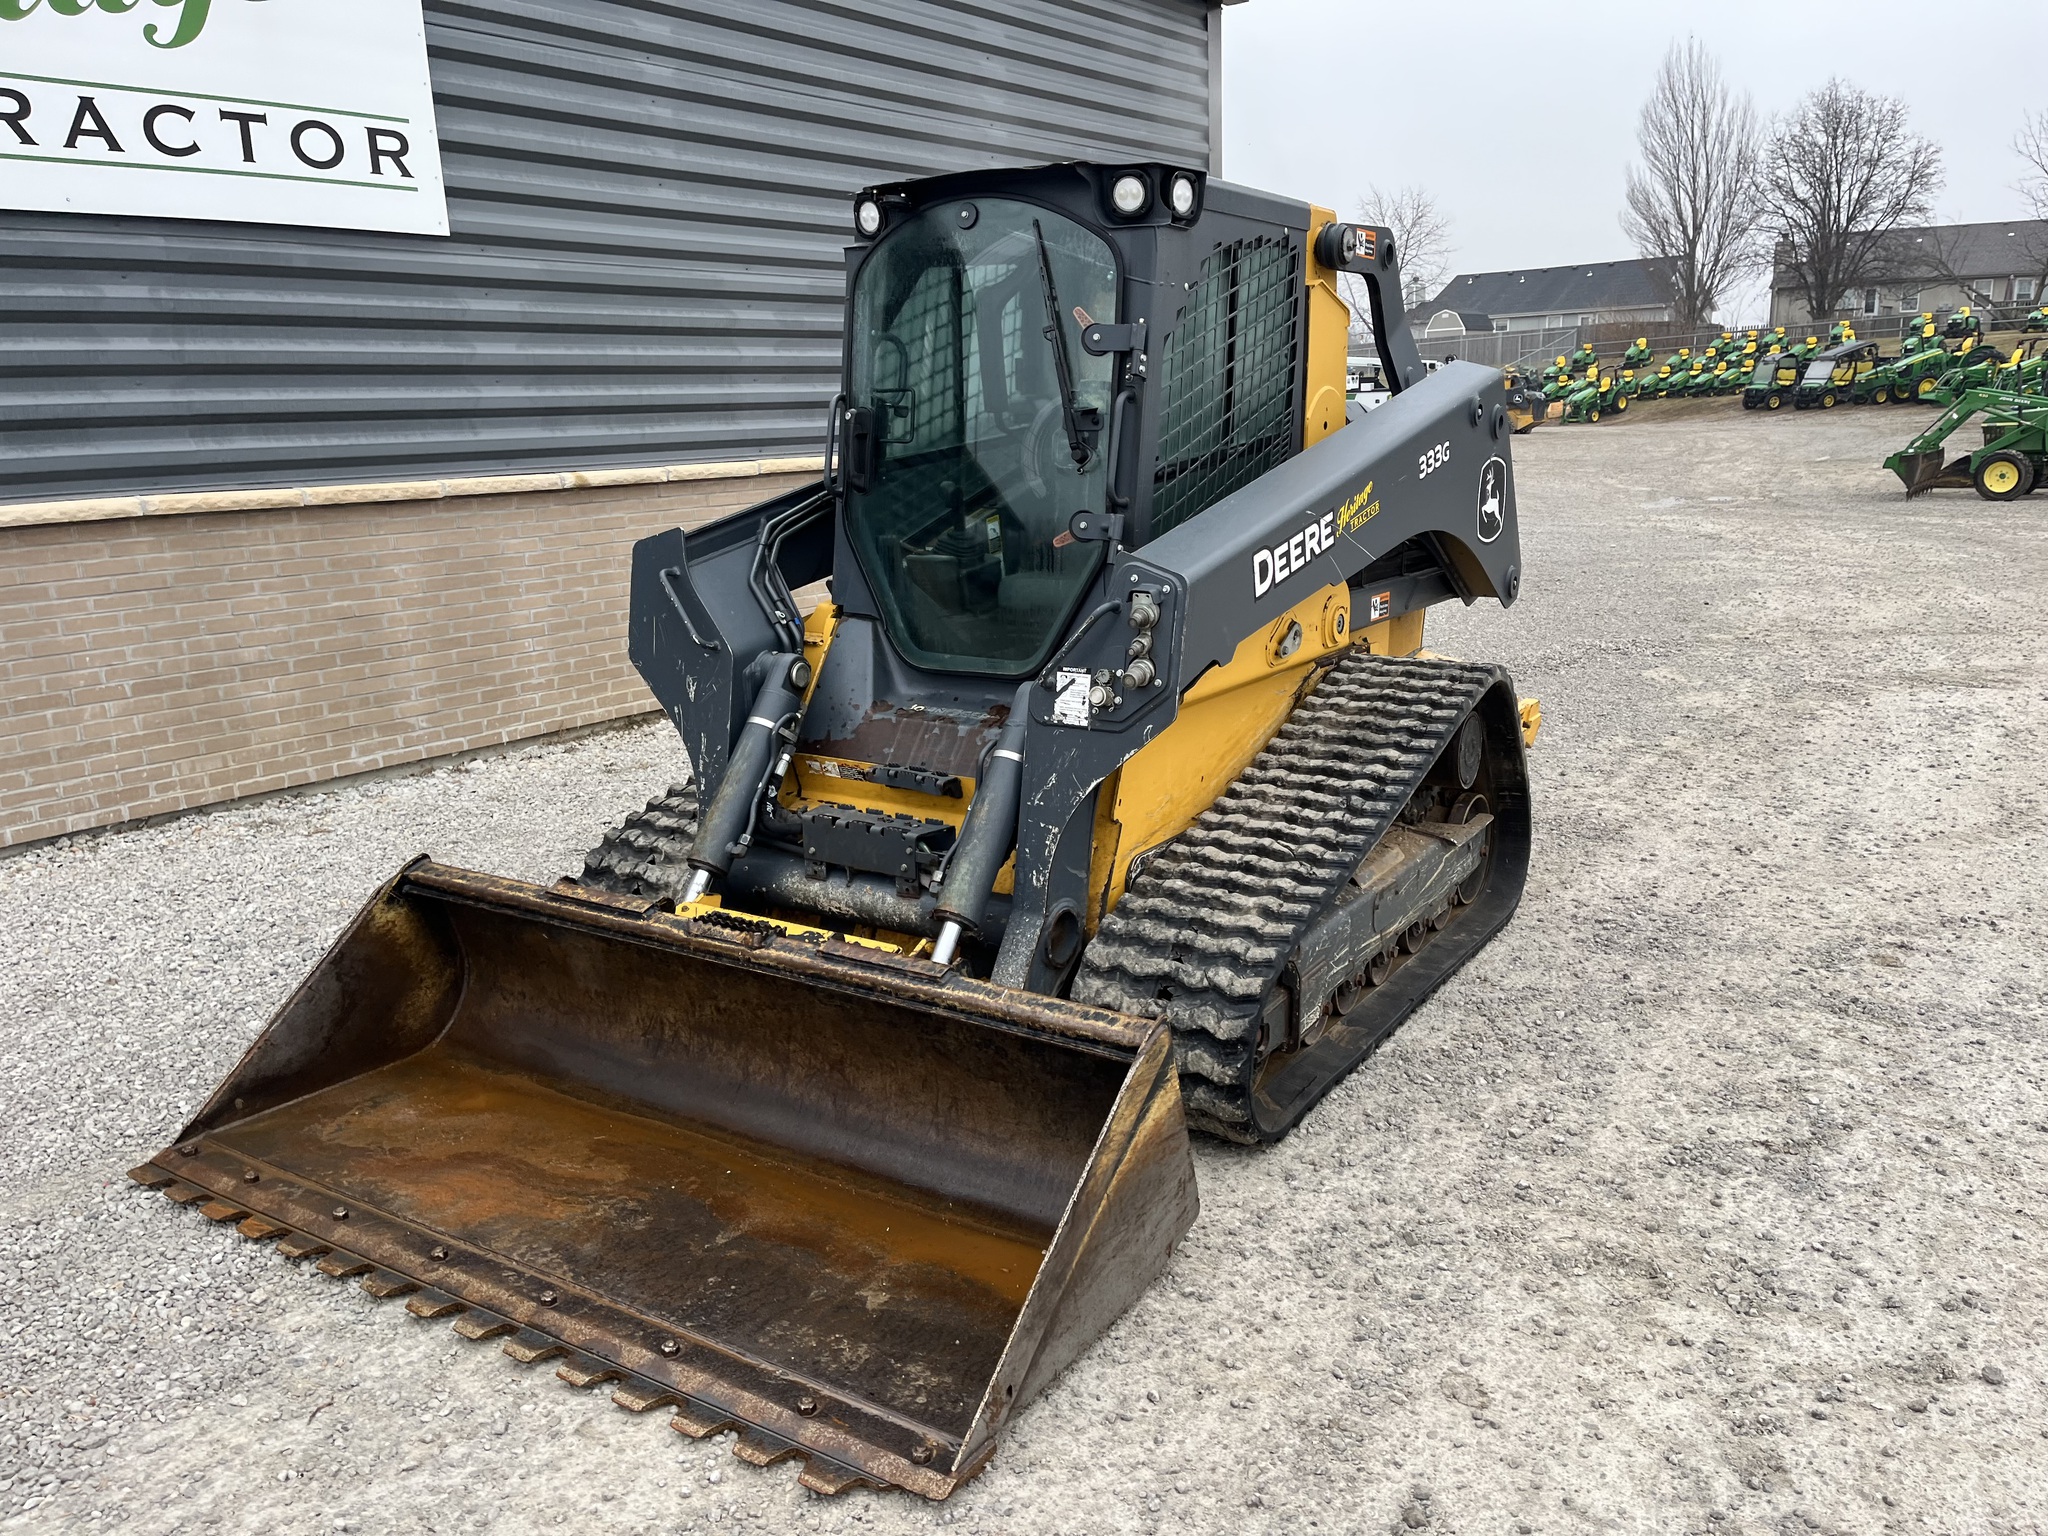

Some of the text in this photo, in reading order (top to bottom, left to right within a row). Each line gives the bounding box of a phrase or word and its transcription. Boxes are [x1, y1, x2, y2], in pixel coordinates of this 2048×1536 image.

[1418, 440, 1450, 480] 333G
[1336, 480, 1374, 538] Heritage
[1350, 502, 1380, 530] TRACTOR
[1253, 511, 1335, 598] DEERE
